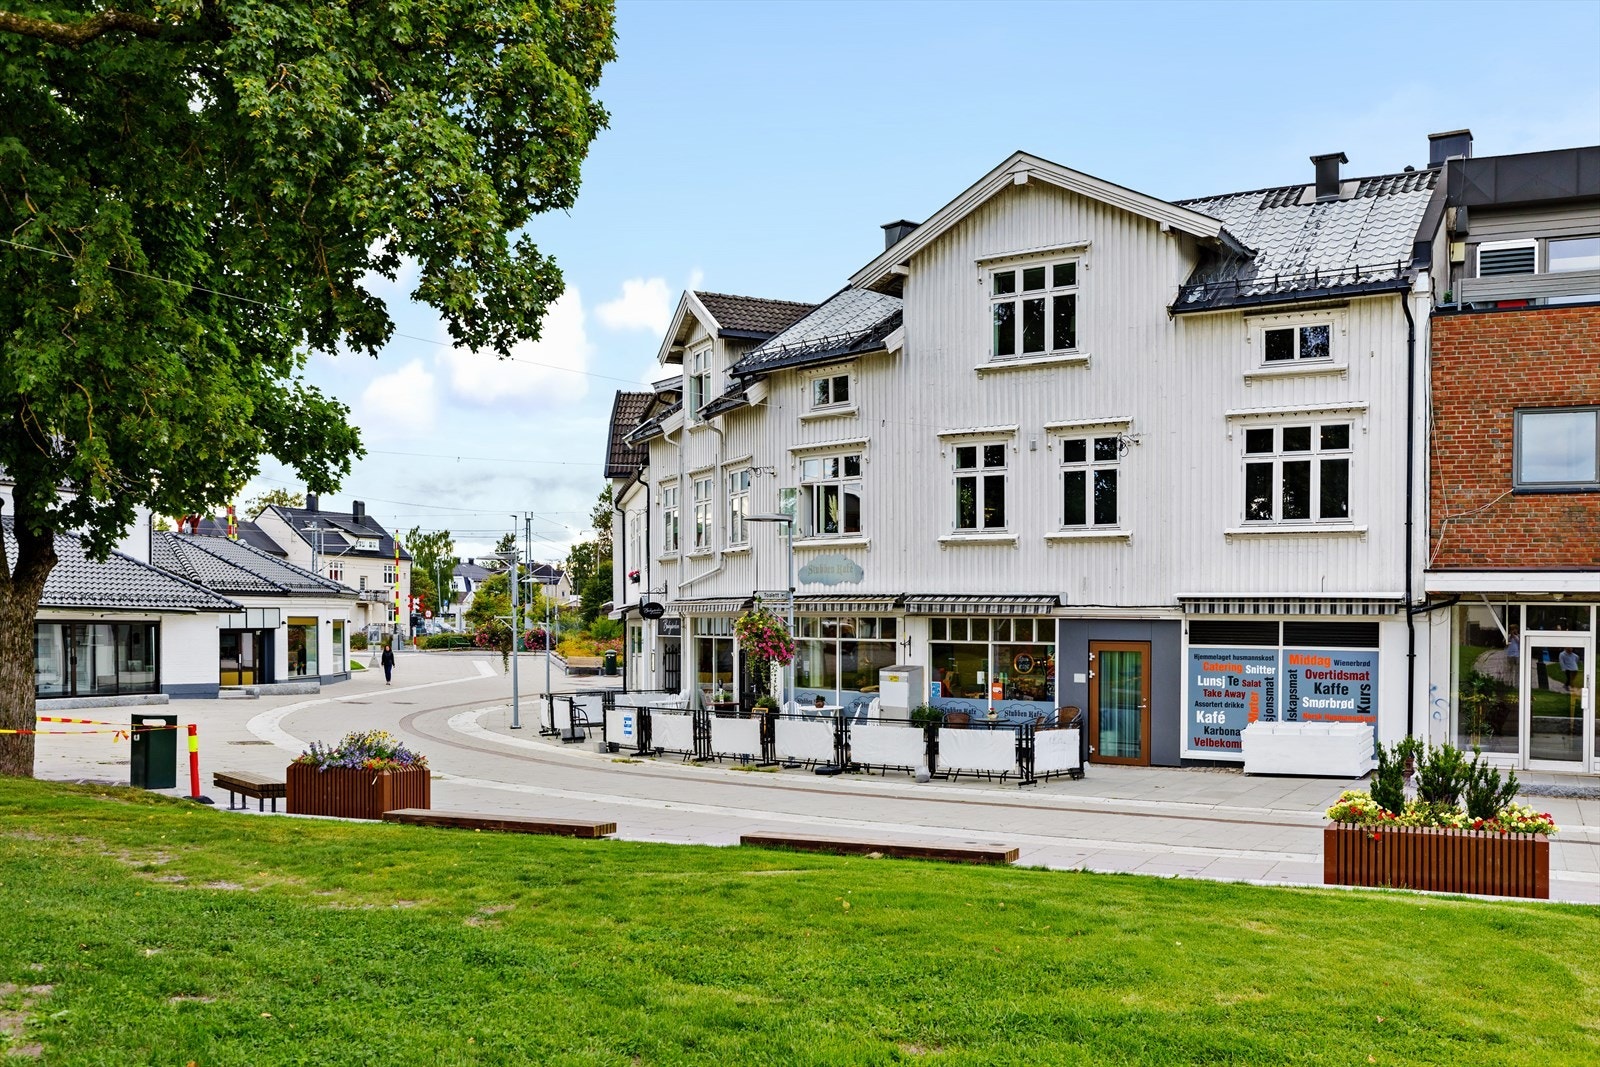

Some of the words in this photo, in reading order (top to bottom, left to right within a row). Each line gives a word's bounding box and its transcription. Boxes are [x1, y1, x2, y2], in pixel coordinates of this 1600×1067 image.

[1193, 653, 1231, 661] Hjemmelaget
[1289, 654, 1331, 668] Middag
[1202, 661, 1243, 674] Catering
[1333, 659, 1371, 667] Wienerbrød
[1245, 664, 1276, 674] Snitter
[1305, 668, 1370, 681] Overtidsmat
[1197, 675, 1226, 689] Lunsj
[1227, 675, 1239, 686] Te
[1241, 679, 1262, 688] Salat
[1314, 682, 1349, 695] Kaffe
[1203, 689, 1222, 698] Take
[1224, 690, 1246, 700] Away
[1264, 676, 1276, 722] sjonsmat
[1356, 683, 1371, 714] Kurs
[1194, 700, 1223, 708] Assortert
[1224, 701, 1245, 709] drikke
[1302, 696, 1355, 710] Smørbrød
[1004, 709, 1028, 718] Stubben
[1196, 710, 1226, 724] Kafé
[1302, 712, 1322, 720] Norsk
[1204, 726, 1241, 736] Karbona
